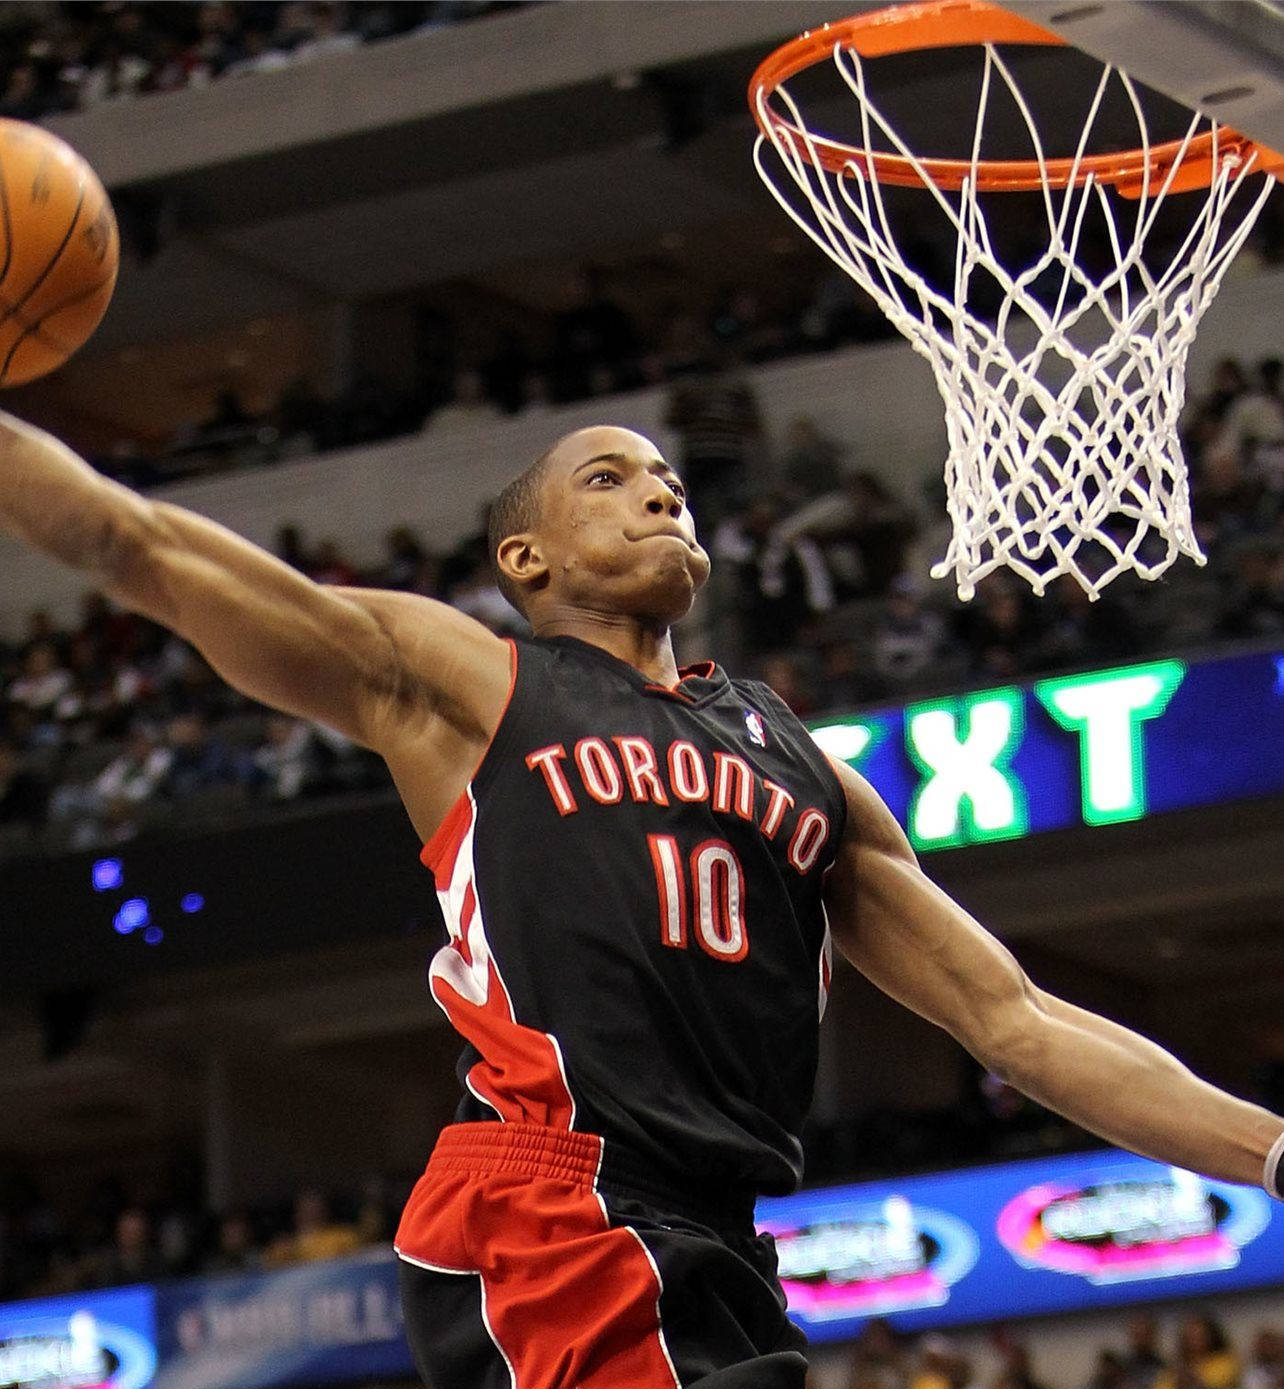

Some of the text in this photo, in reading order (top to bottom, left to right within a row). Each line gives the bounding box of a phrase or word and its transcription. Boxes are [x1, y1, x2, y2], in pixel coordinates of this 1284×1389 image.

[525, 736, 830, 875] TORONTO
[810, 659, 1187, 853] XT
[647, 833, 749, 963] 10
